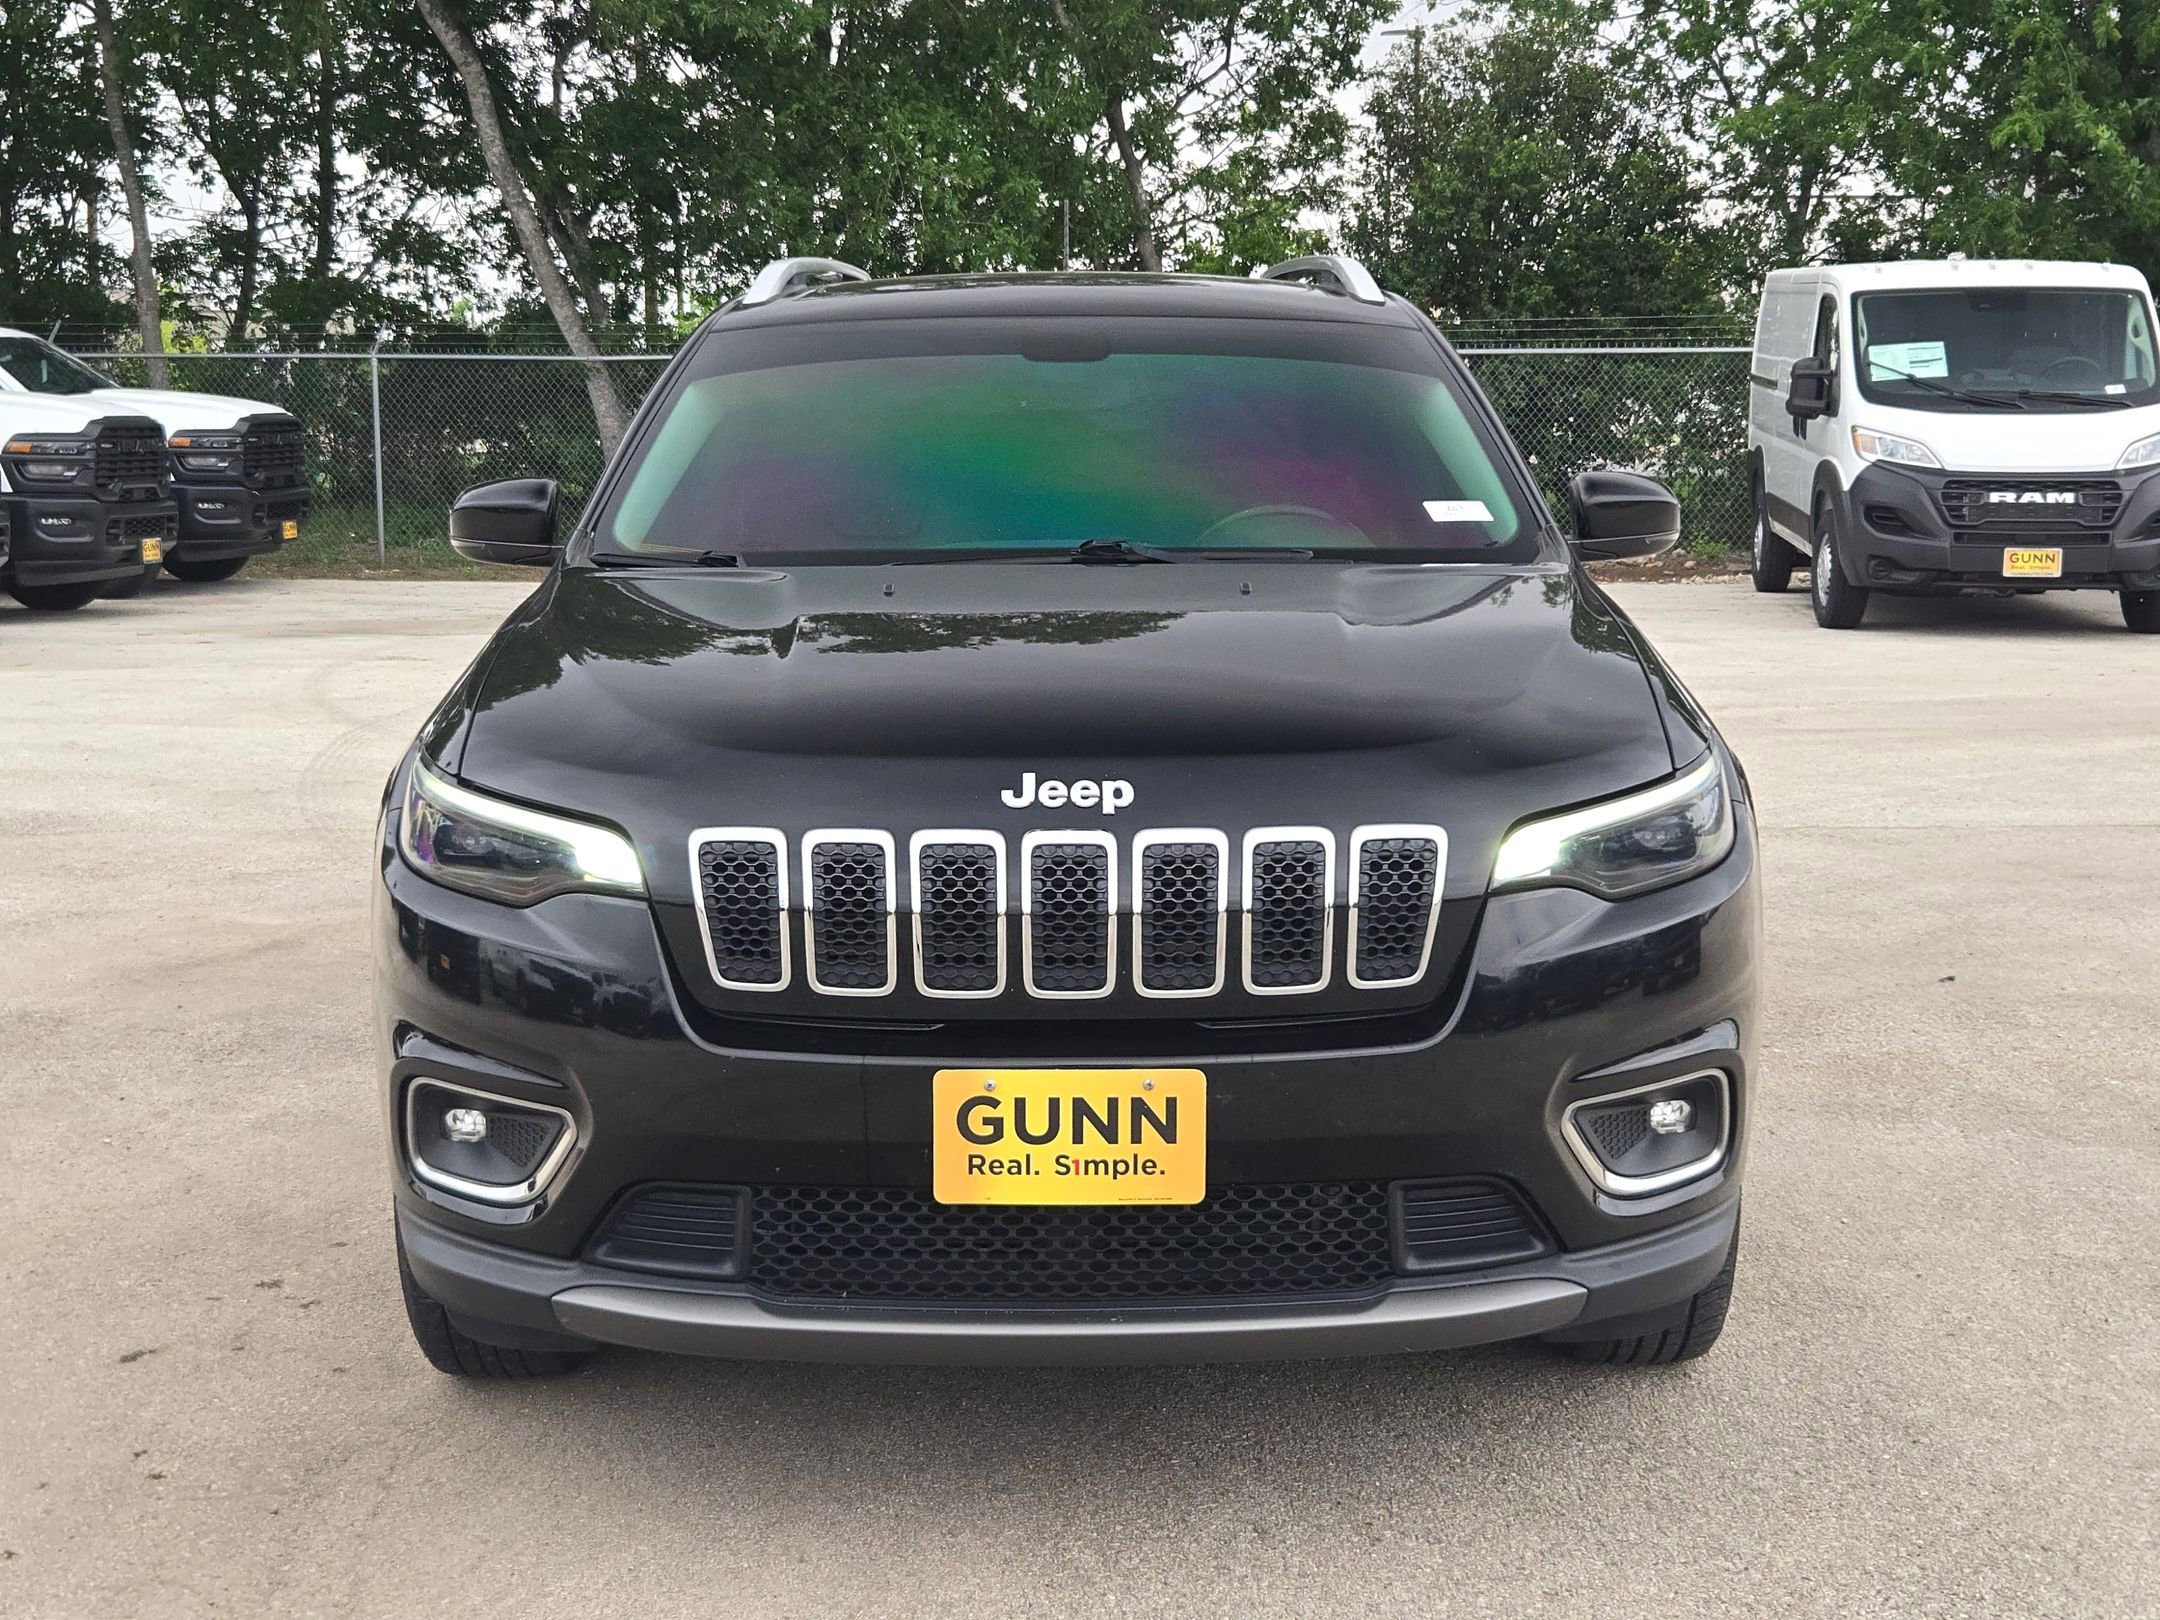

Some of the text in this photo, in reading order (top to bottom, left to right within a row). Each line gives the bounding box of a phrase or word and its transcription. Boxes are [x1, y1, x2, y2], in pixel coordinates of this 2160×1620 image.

[1988, 491, 2075, 504] RAM
[2009, 552, 2056, 564] GUNN
[1000, 772, 1135, 815] Jeep
[956, 1095, 1178, 1146] GUNN
[967, 1153, 1040, 1176] Real.
